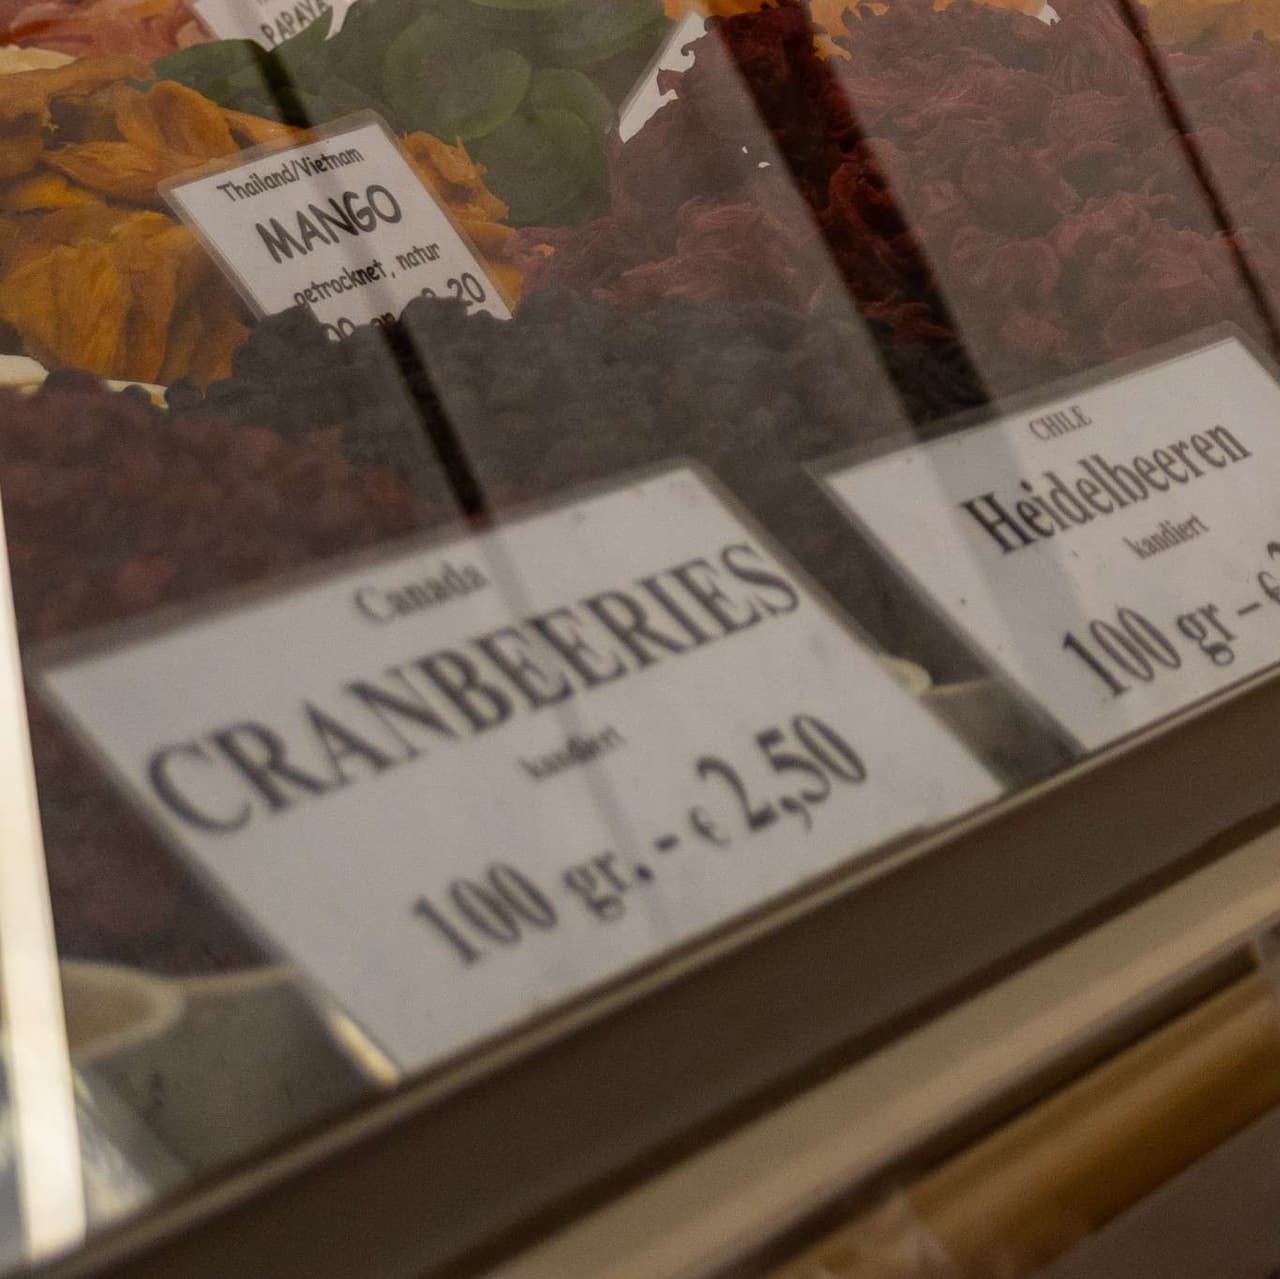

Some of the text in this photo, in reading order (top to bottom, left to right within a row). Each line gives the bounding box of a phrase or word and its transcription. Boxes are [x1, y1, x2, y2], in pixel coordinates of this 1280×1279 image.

[216, 146, 365, 203] Thailand/Vietnam
[255, 184, 402, 265] MANGO
[396, 241, 441, 272] natur
[1027, 404, 1093, 442] CHILE
[959, 422, 1253, 555] Heidelbeeren
[1121, 512, 1211, 561] kandiert
[350, 558, 489, 626] Canada
[1062, 604, 1182, 698] 100
[1175, 601, 1237, 668] gr
[145, 541, 801, 837] CRANBEERIES
[411, 860, 559, 967] 100
[695, 712, 868, 833] 2,50
